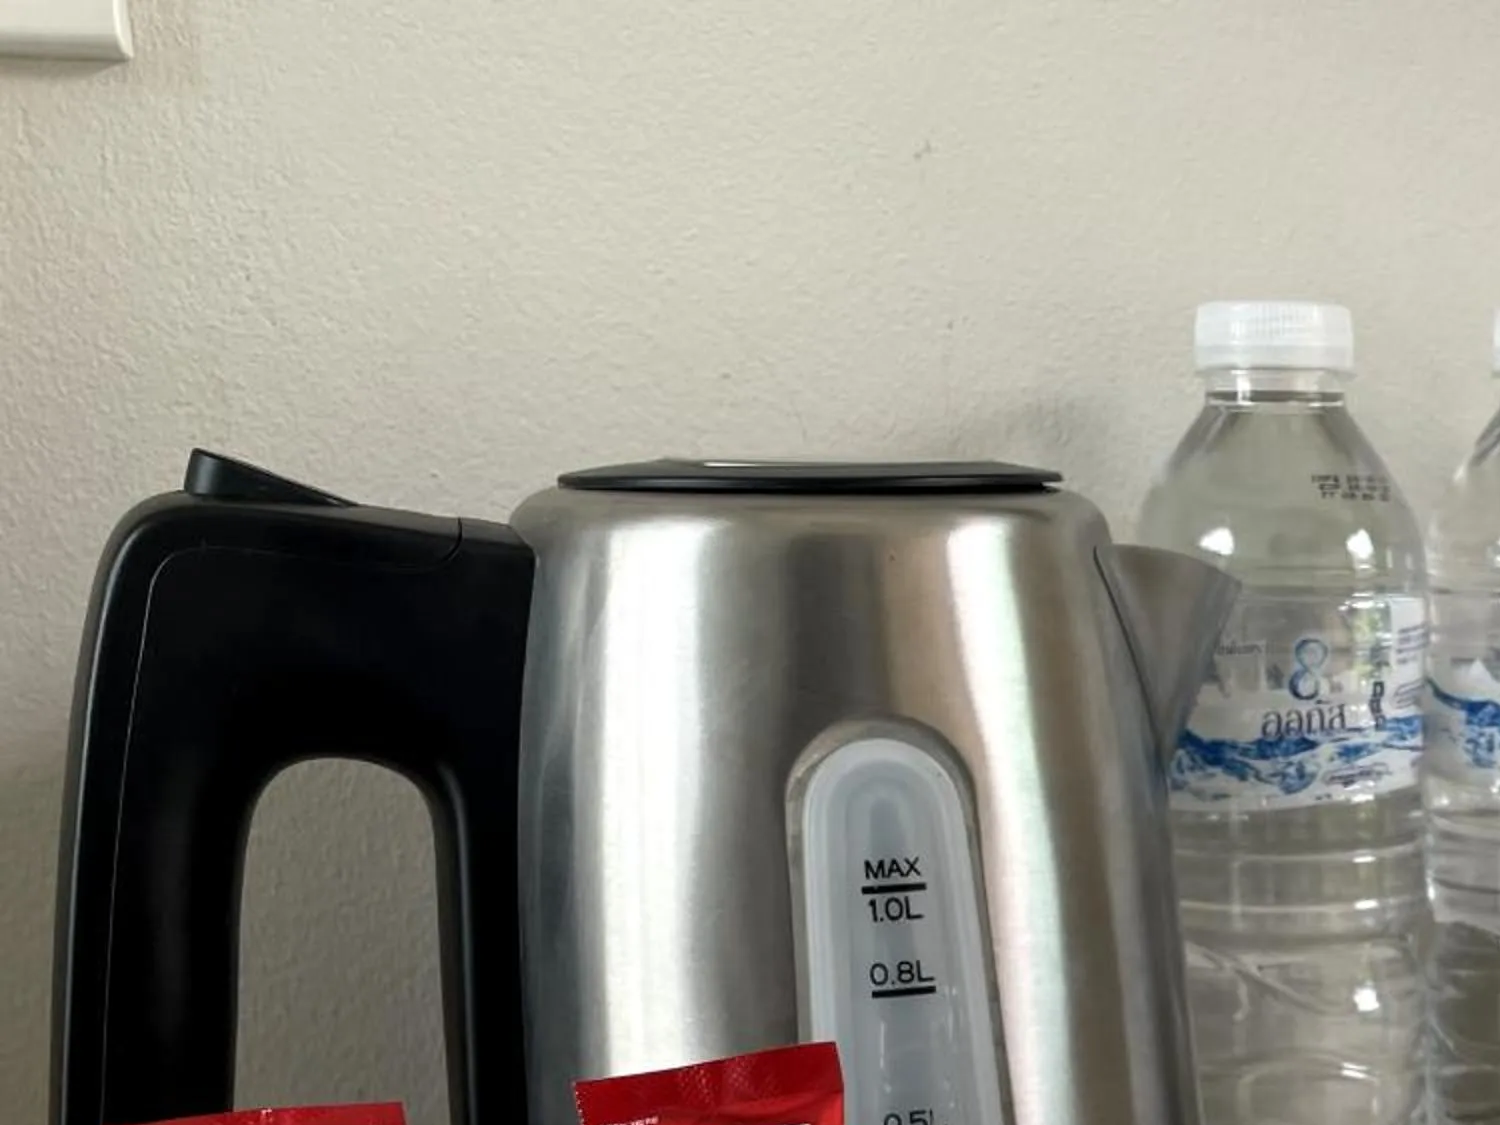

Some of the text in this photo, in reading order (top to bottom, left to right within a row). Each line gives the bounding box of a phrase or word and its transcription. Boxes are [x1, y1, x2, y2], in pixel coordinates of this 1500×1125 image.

[863, 857, 922, 880] MAX
[868, 896, 924, 922] 1.0L
[869, 960, 935, 986] 0.8L
